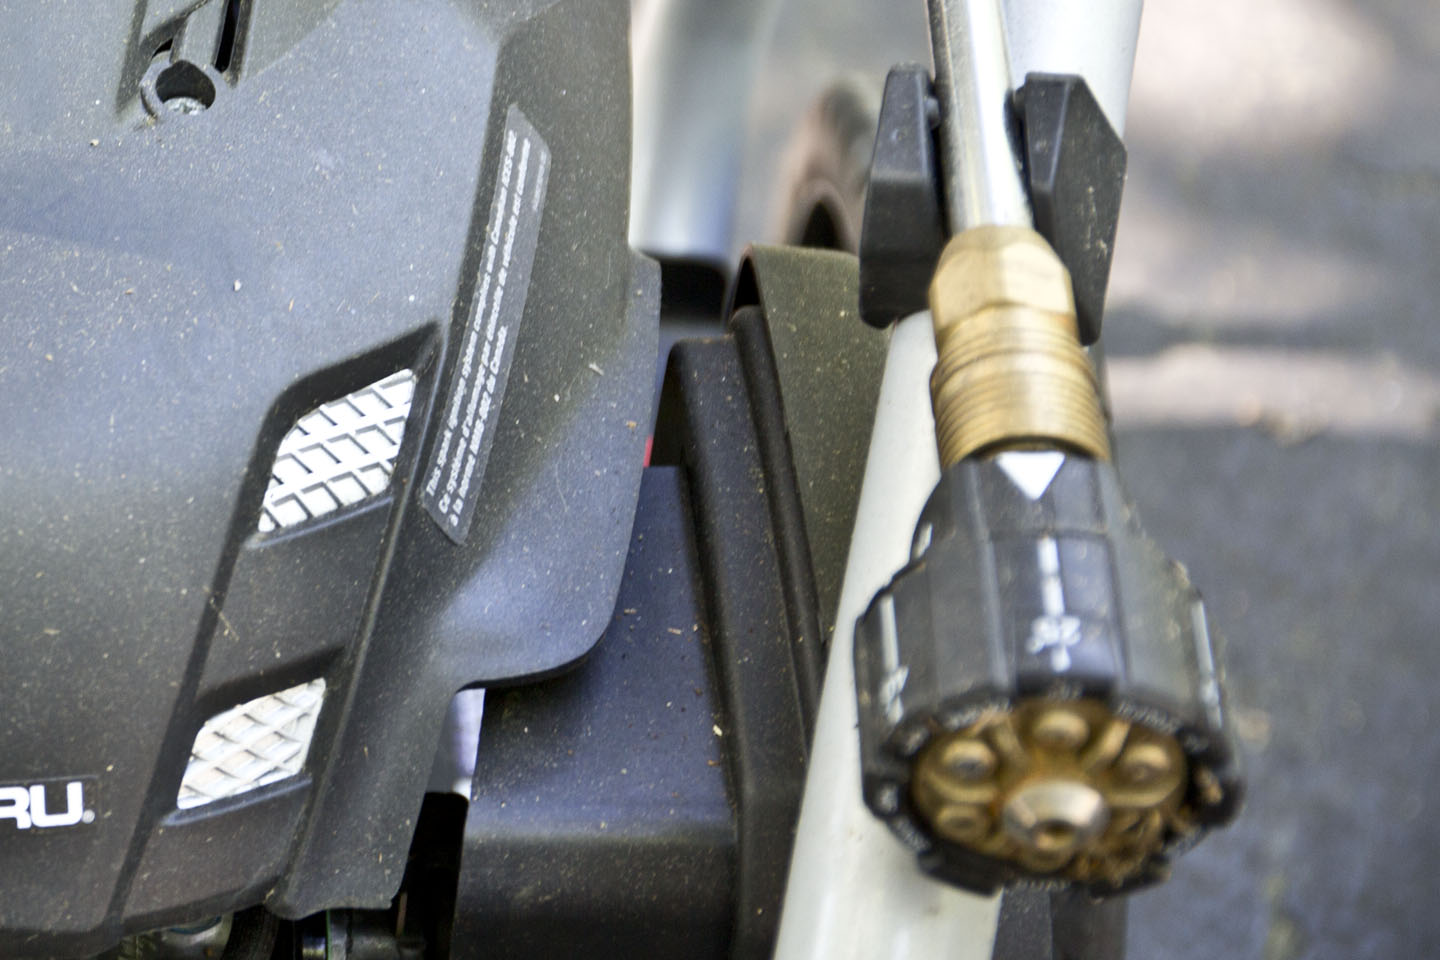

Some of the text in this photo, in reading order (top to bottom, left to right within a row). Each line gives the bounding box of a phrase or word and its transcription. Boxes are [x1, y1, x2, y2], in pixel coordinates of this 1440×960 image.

[425, 466, 441, 496] This
[436, 429, 452, 467] spark
[461, 330, 477, 378] system
[438, 493, 450, 513] Ce
[446, 437, 466, 493] système
